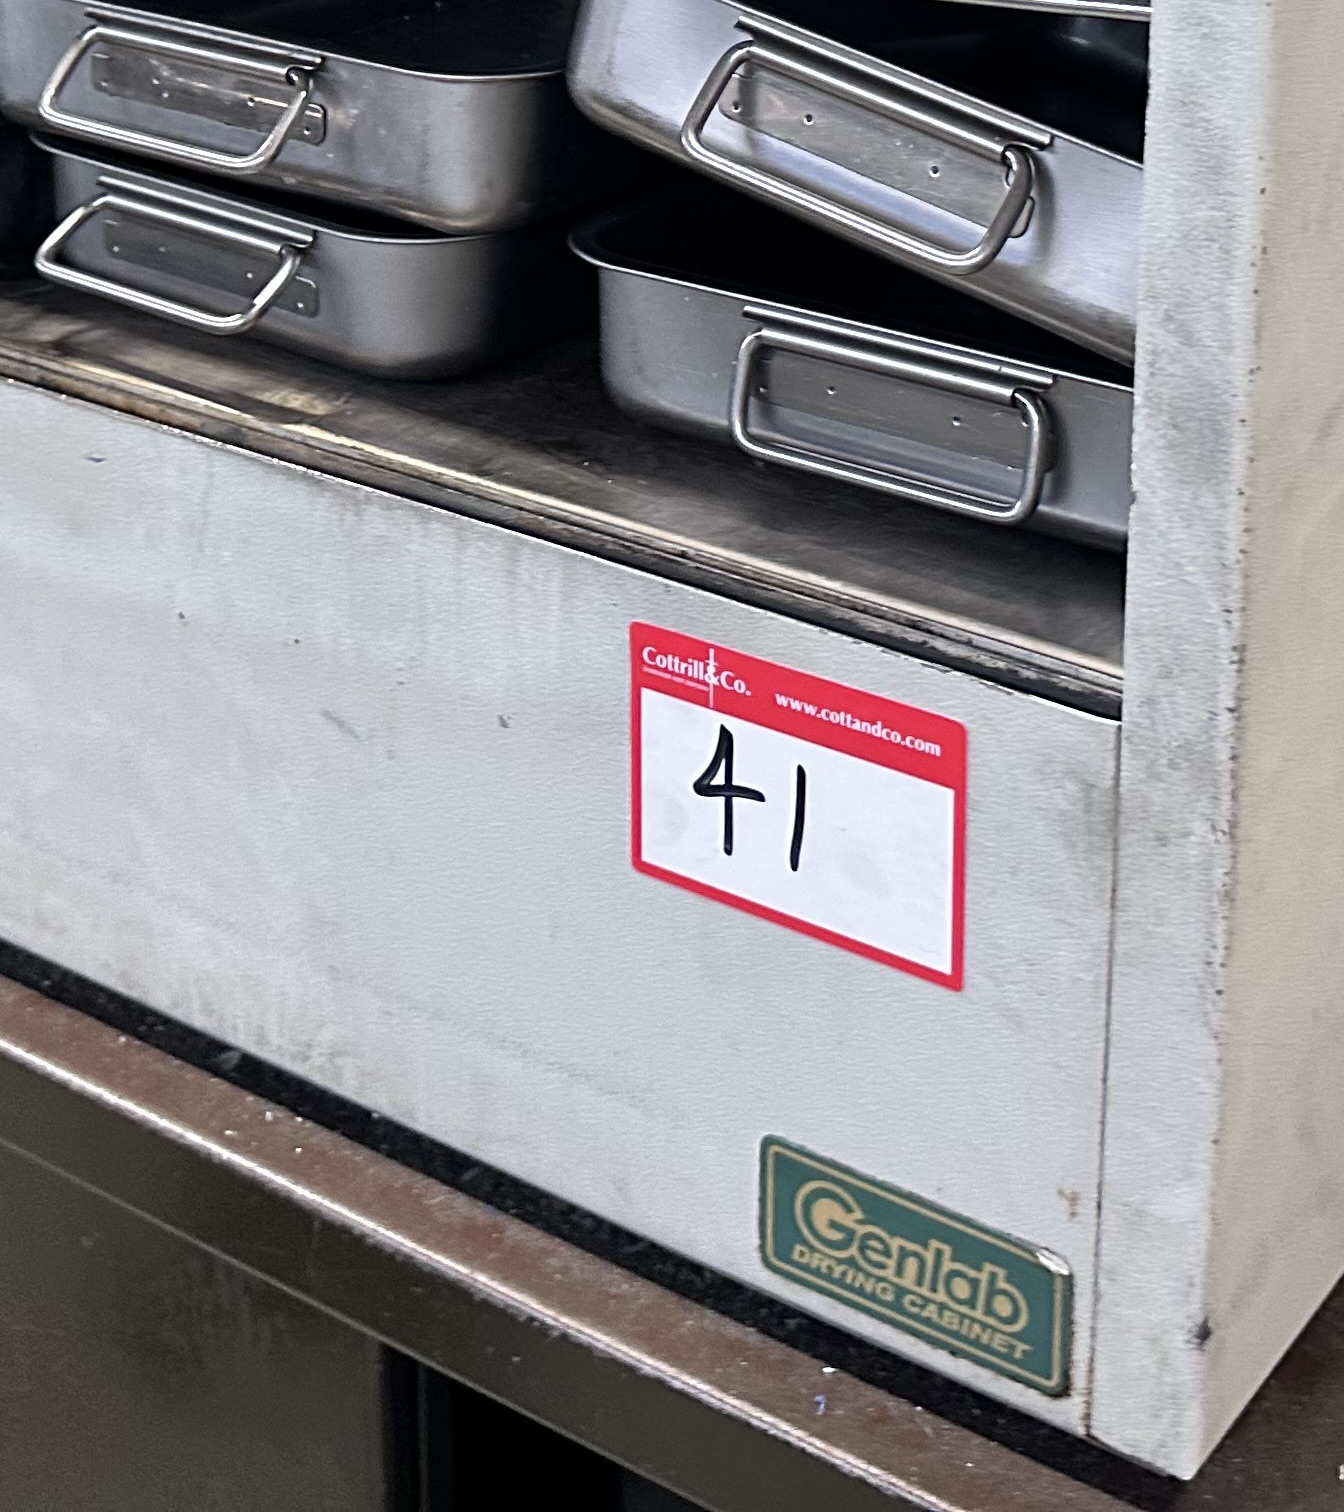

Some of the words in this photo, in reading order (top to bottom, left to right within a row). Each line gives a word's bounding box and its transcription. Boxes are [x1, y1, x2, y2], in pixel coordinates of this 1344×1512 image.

[774, 691, 942, 758] www.cottandco.com
[693, 724, 806, 872] 41
[791, 1243, 896, 1302] DRYING
[903, 1293, 1035, 1360] CABINET
[794, 1179, 1030, 1333] Genlab
